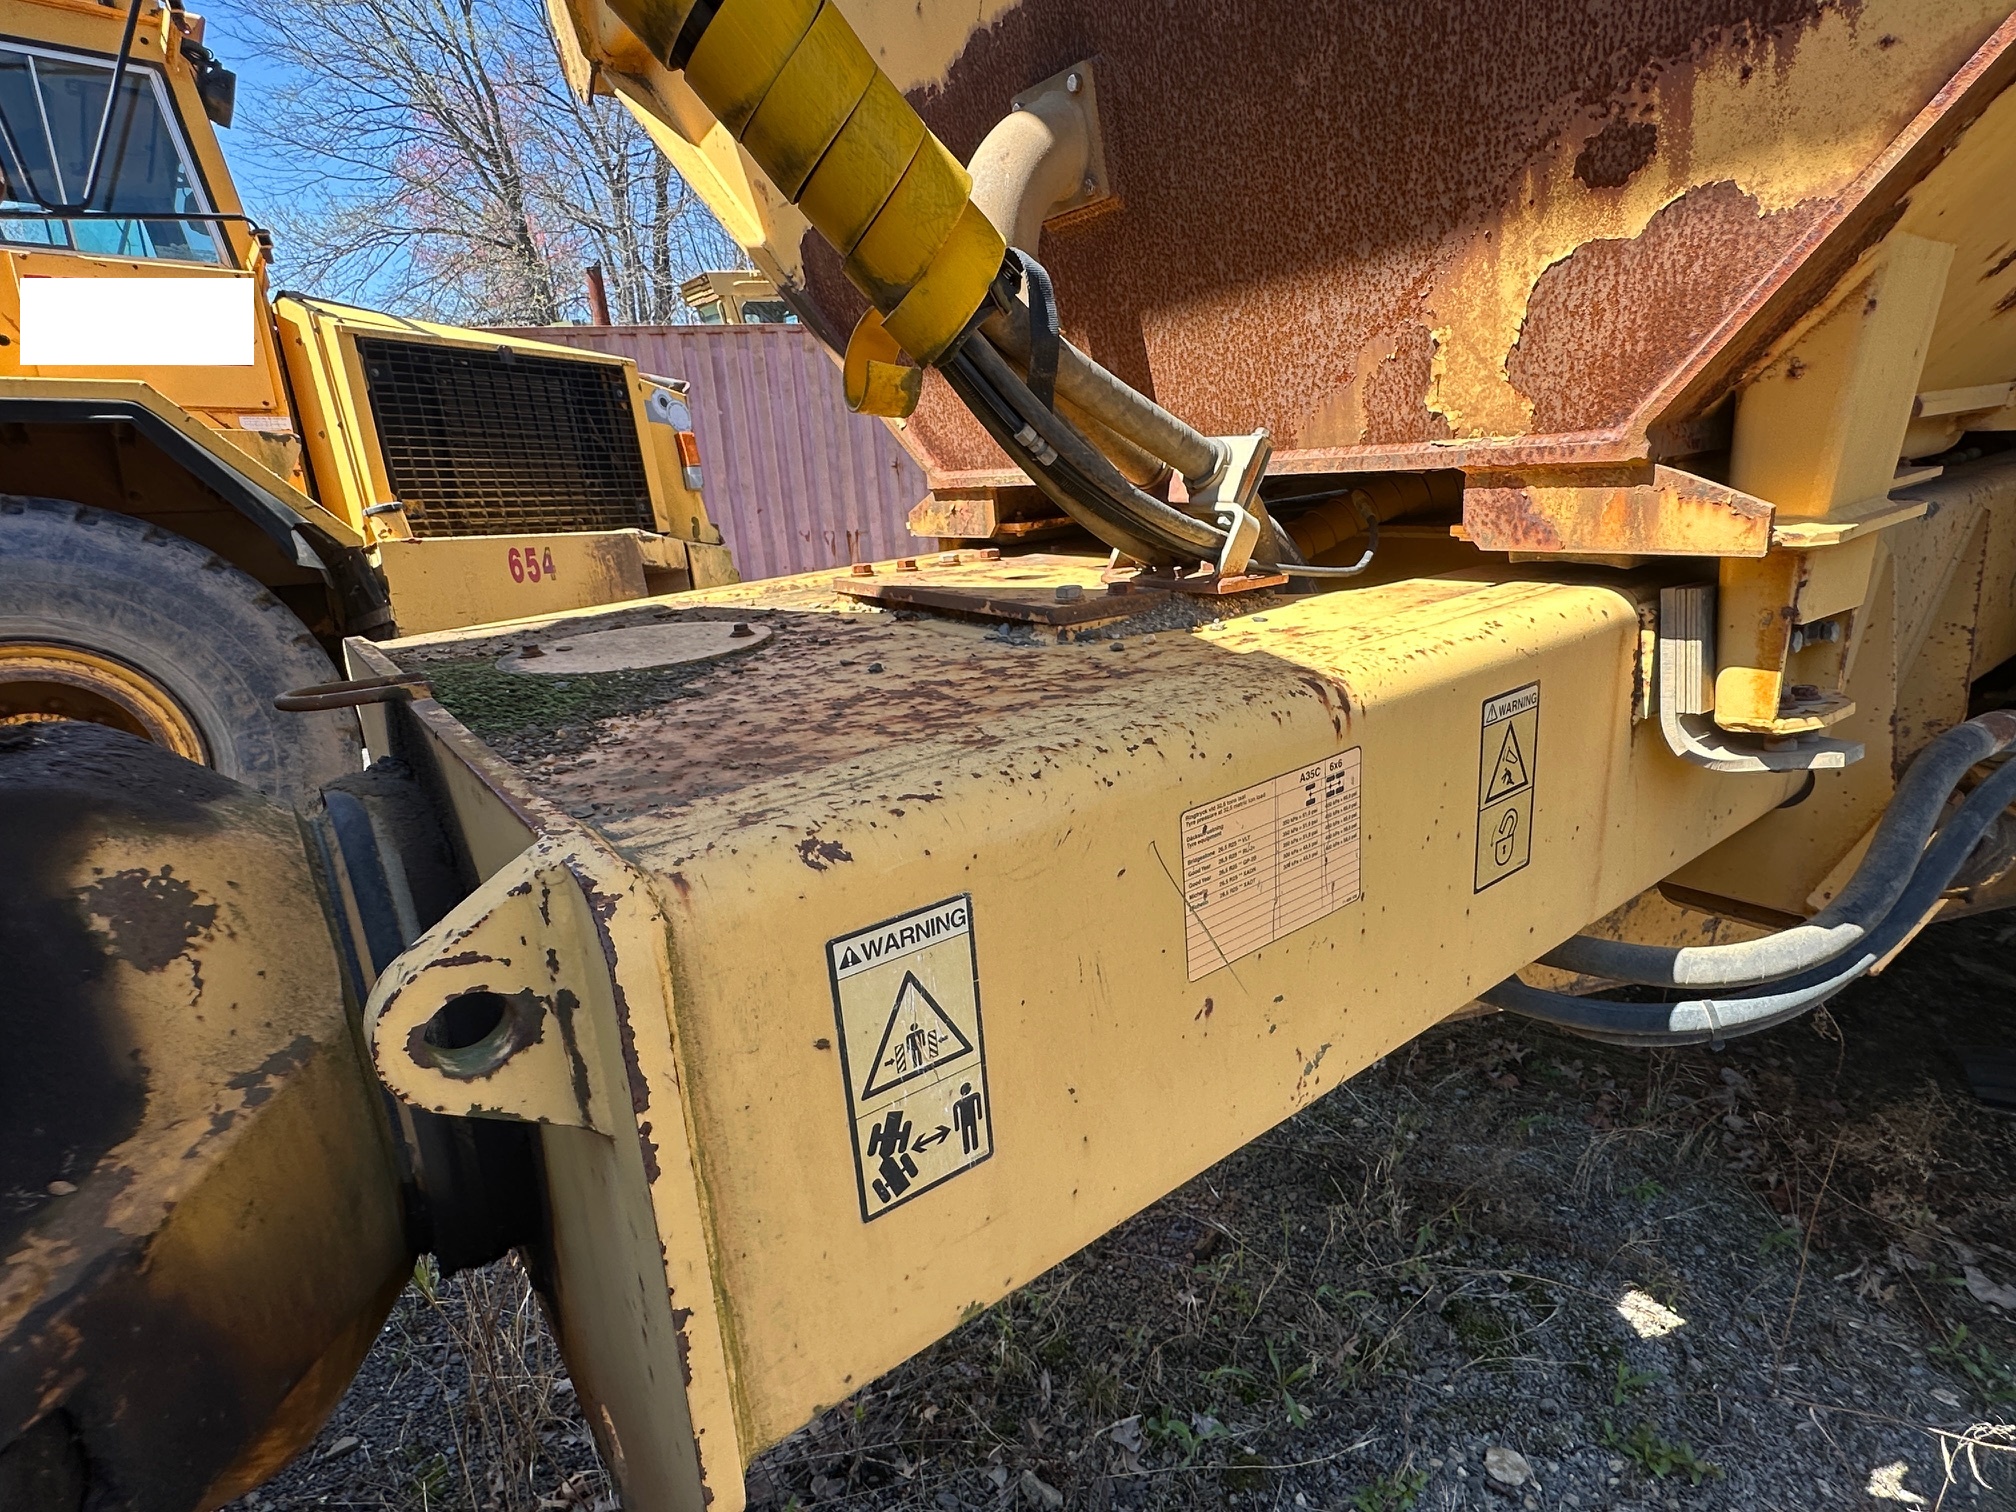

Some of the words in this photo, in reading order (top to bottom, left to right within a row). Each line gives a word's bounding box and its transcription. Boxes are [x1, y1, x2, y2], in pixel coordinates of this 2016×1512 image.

[508, 546, 556, 584] 654
[1499, 692, 1537, 717] WARNING
[1300, 767, 1321, 783] A35C
[1330, 759, 1343, 771] 6x6
[1197, 812, 1217, 824] pressure
[1187, 841, 1197, 849] Tyre
[1198, 831, 1222, 844] equipment
[1188, 850, 1215, 865] Bridgestone
[1188, 868, 1201, 876] Good
[1188, 880, 1201, 888] Good
[861, 907, 966, 960] WARNING
